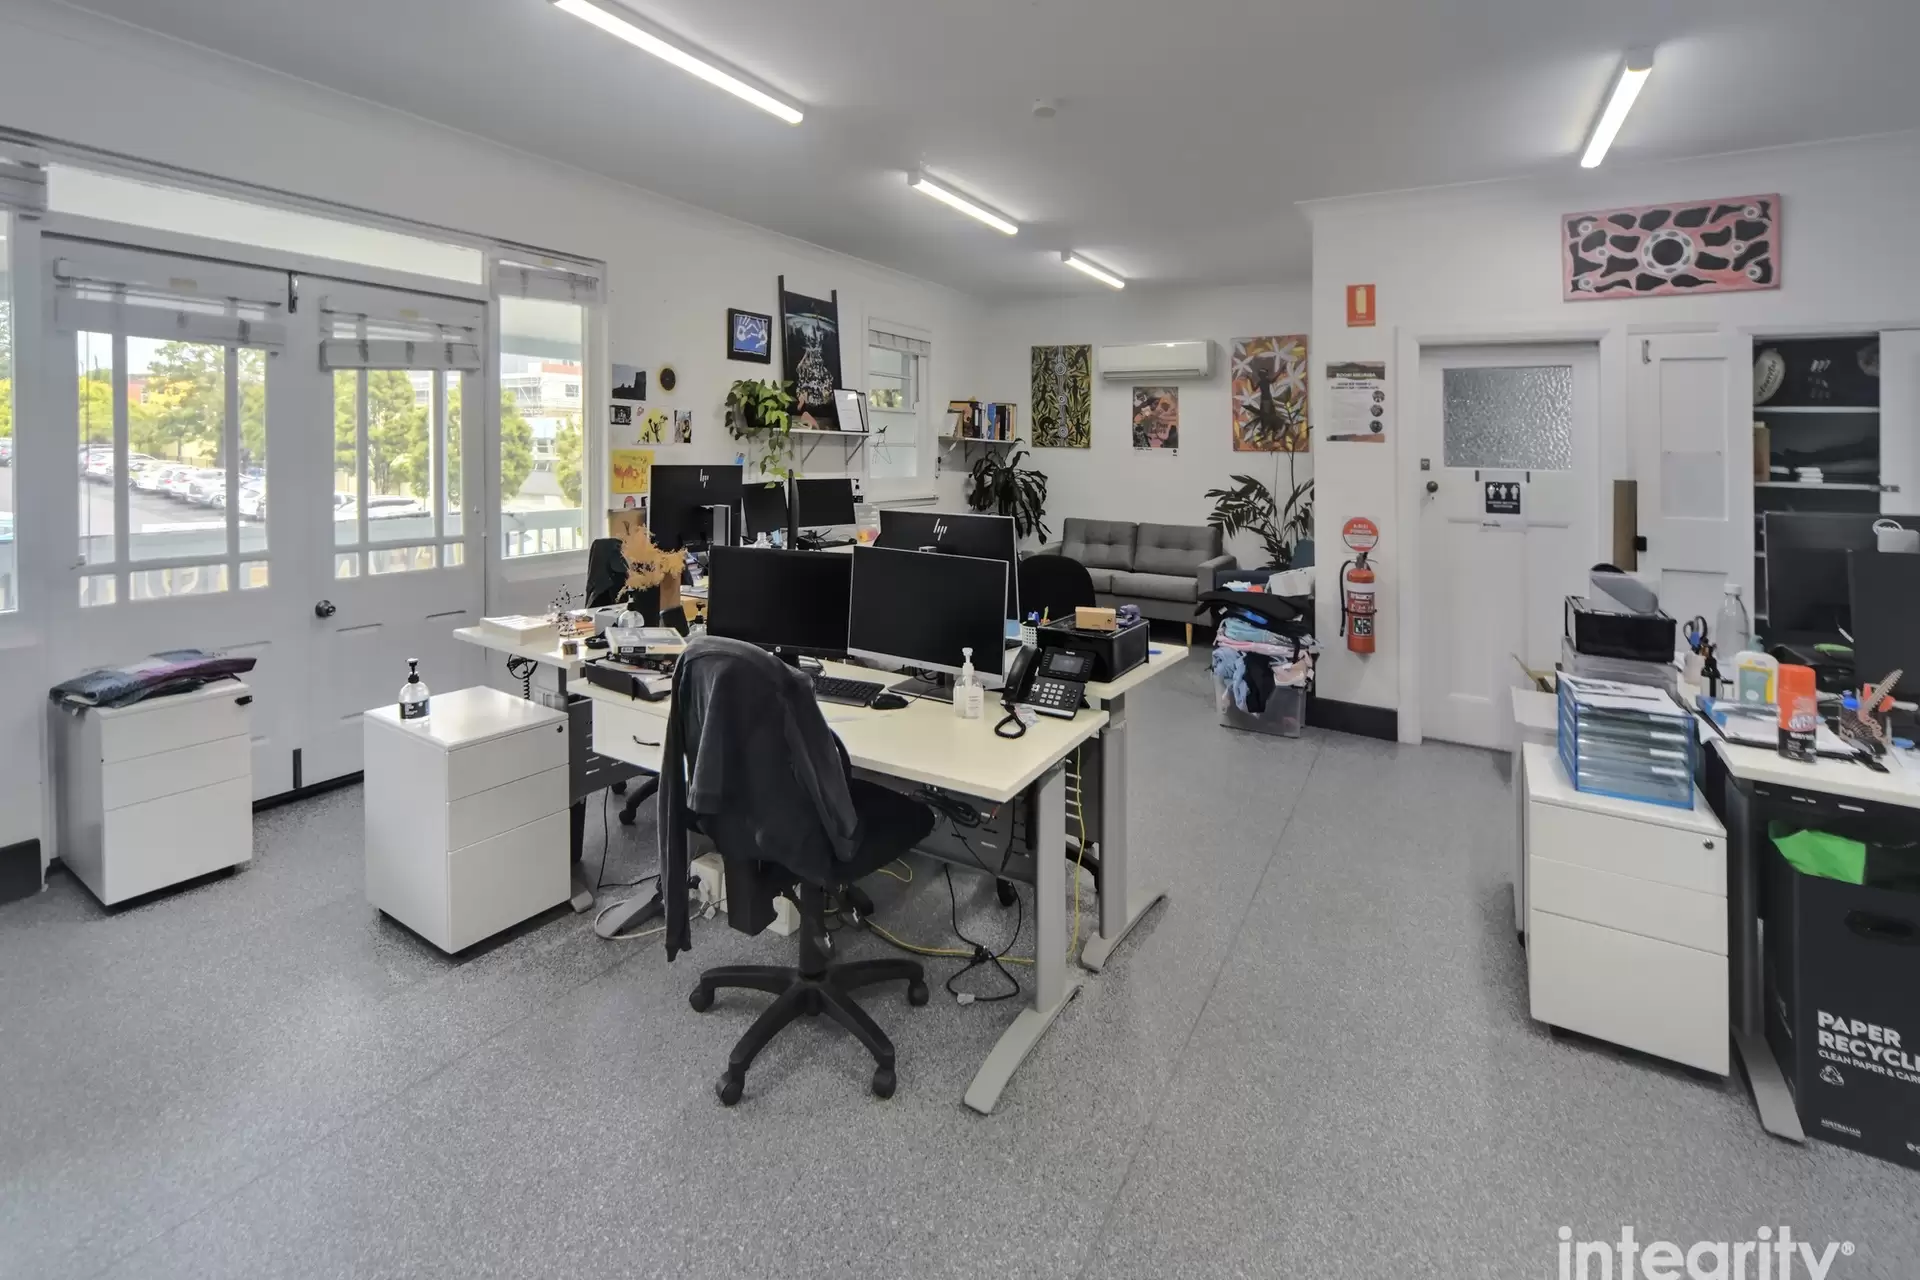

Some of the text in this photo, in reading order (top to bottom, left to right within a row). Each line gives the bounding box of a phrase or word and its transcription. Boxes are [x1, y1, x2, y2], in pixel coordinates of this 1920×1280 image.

[933, 518, 948, 541] hp
[1818, 1010, 1901, 1048] PAPER
[1818, 1049, 1852, 1065] CLEAN
[1852, 1058, 1886, 1075] PAPER
[1886, 1068, 1895, 1078] &
